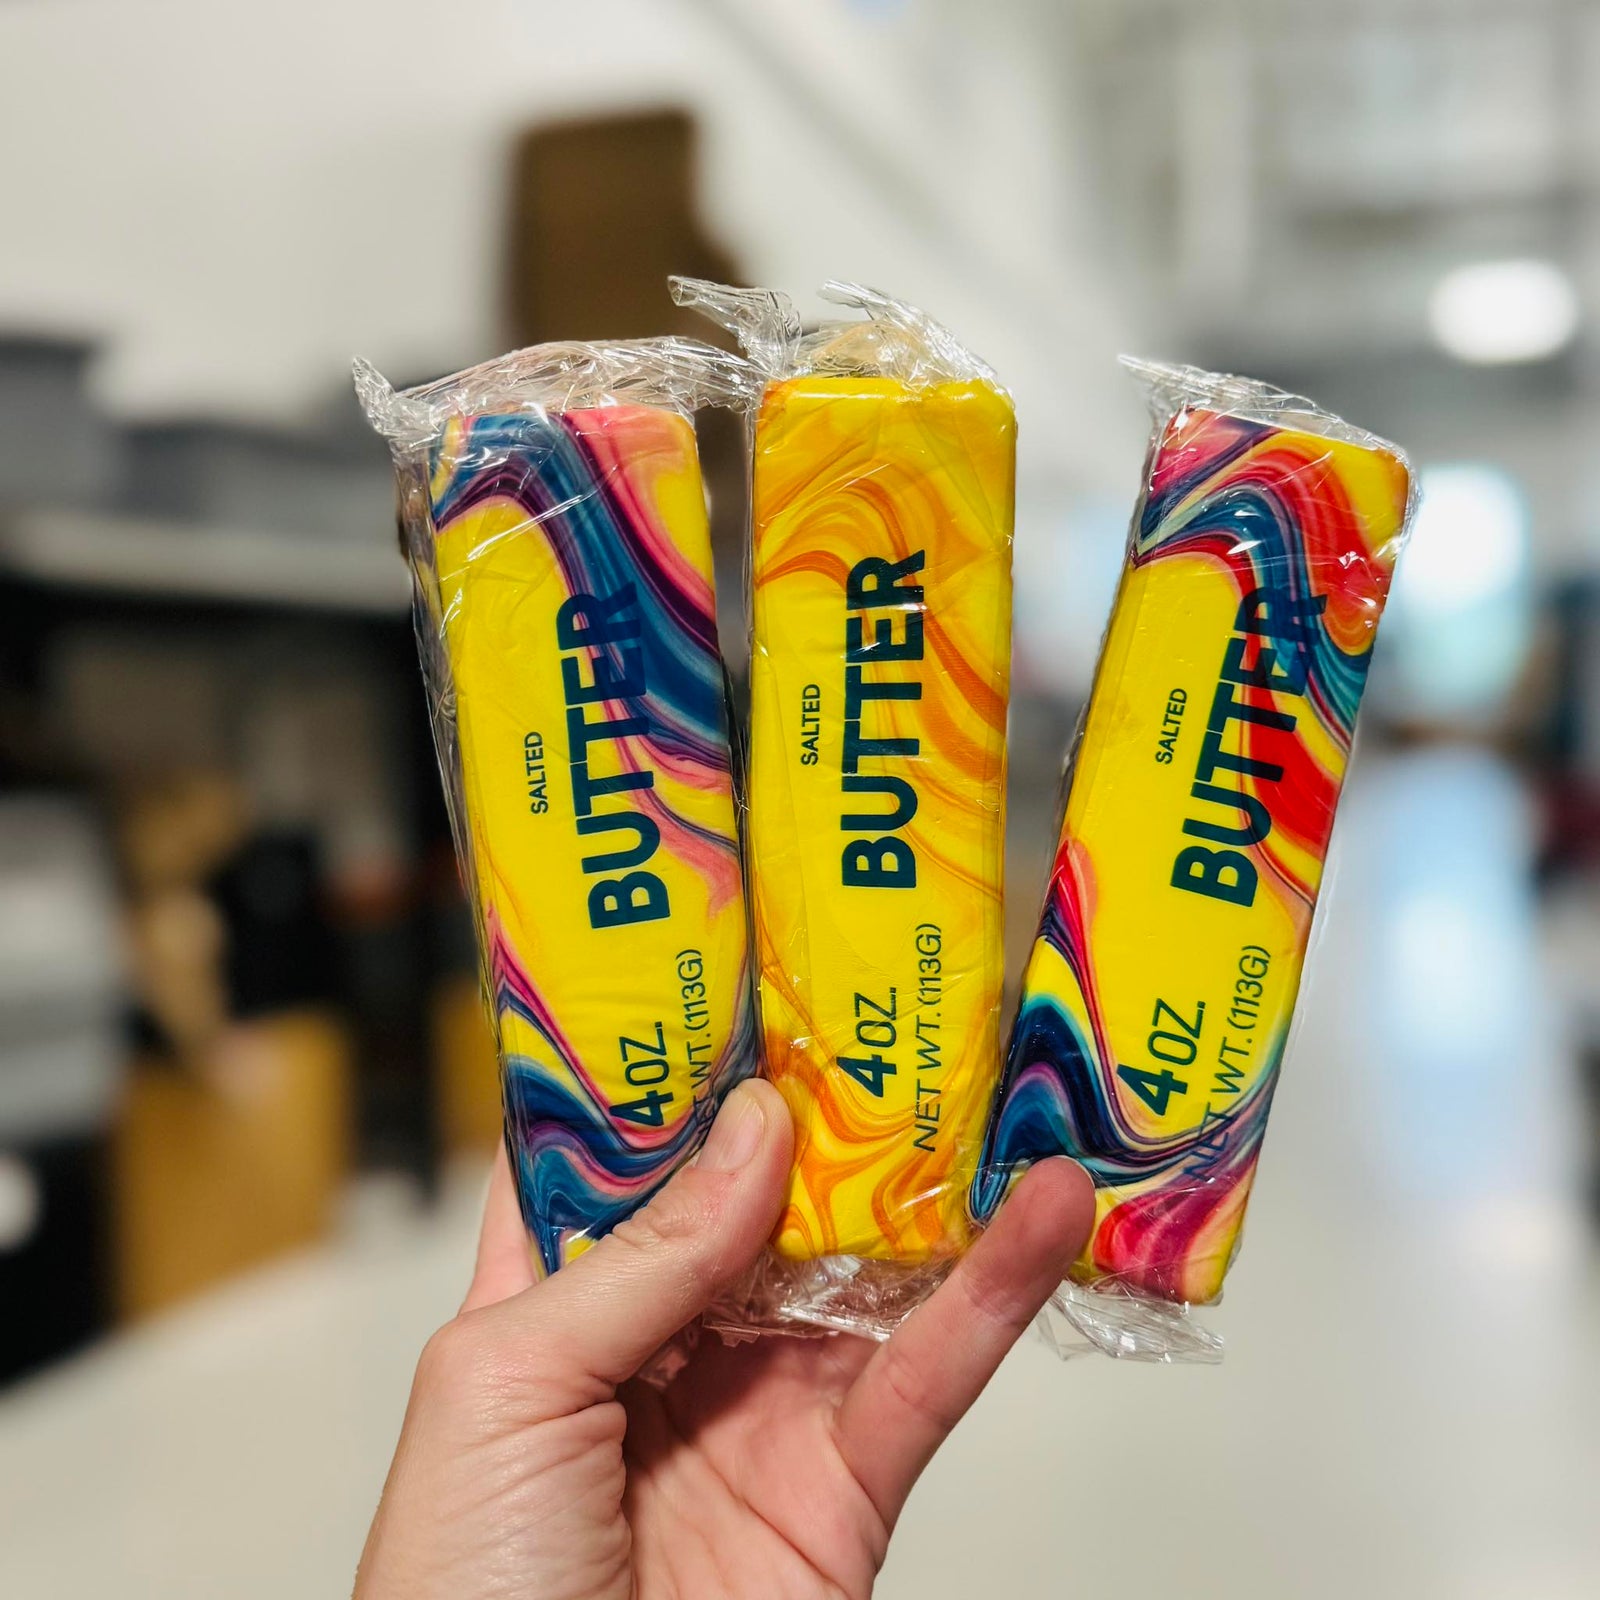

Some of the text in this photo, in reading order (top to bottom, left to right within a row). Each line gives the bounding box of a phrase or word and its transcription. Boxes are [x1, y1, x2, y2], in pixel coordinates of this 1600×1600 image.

[556, 581, 671, 930] BUTTER
[800, 683, 821, 766] SALTED
[839, 549, 925, 888] BUTTER
[1155, 688, 1188, 765] SALTED
[1169, 586, 1328, 907] BUTTER
[524, 731, 549, 814] SALTED
[913, 1079, 942, 1152] NET
[1182, 1102, 1235, 1181] NET
